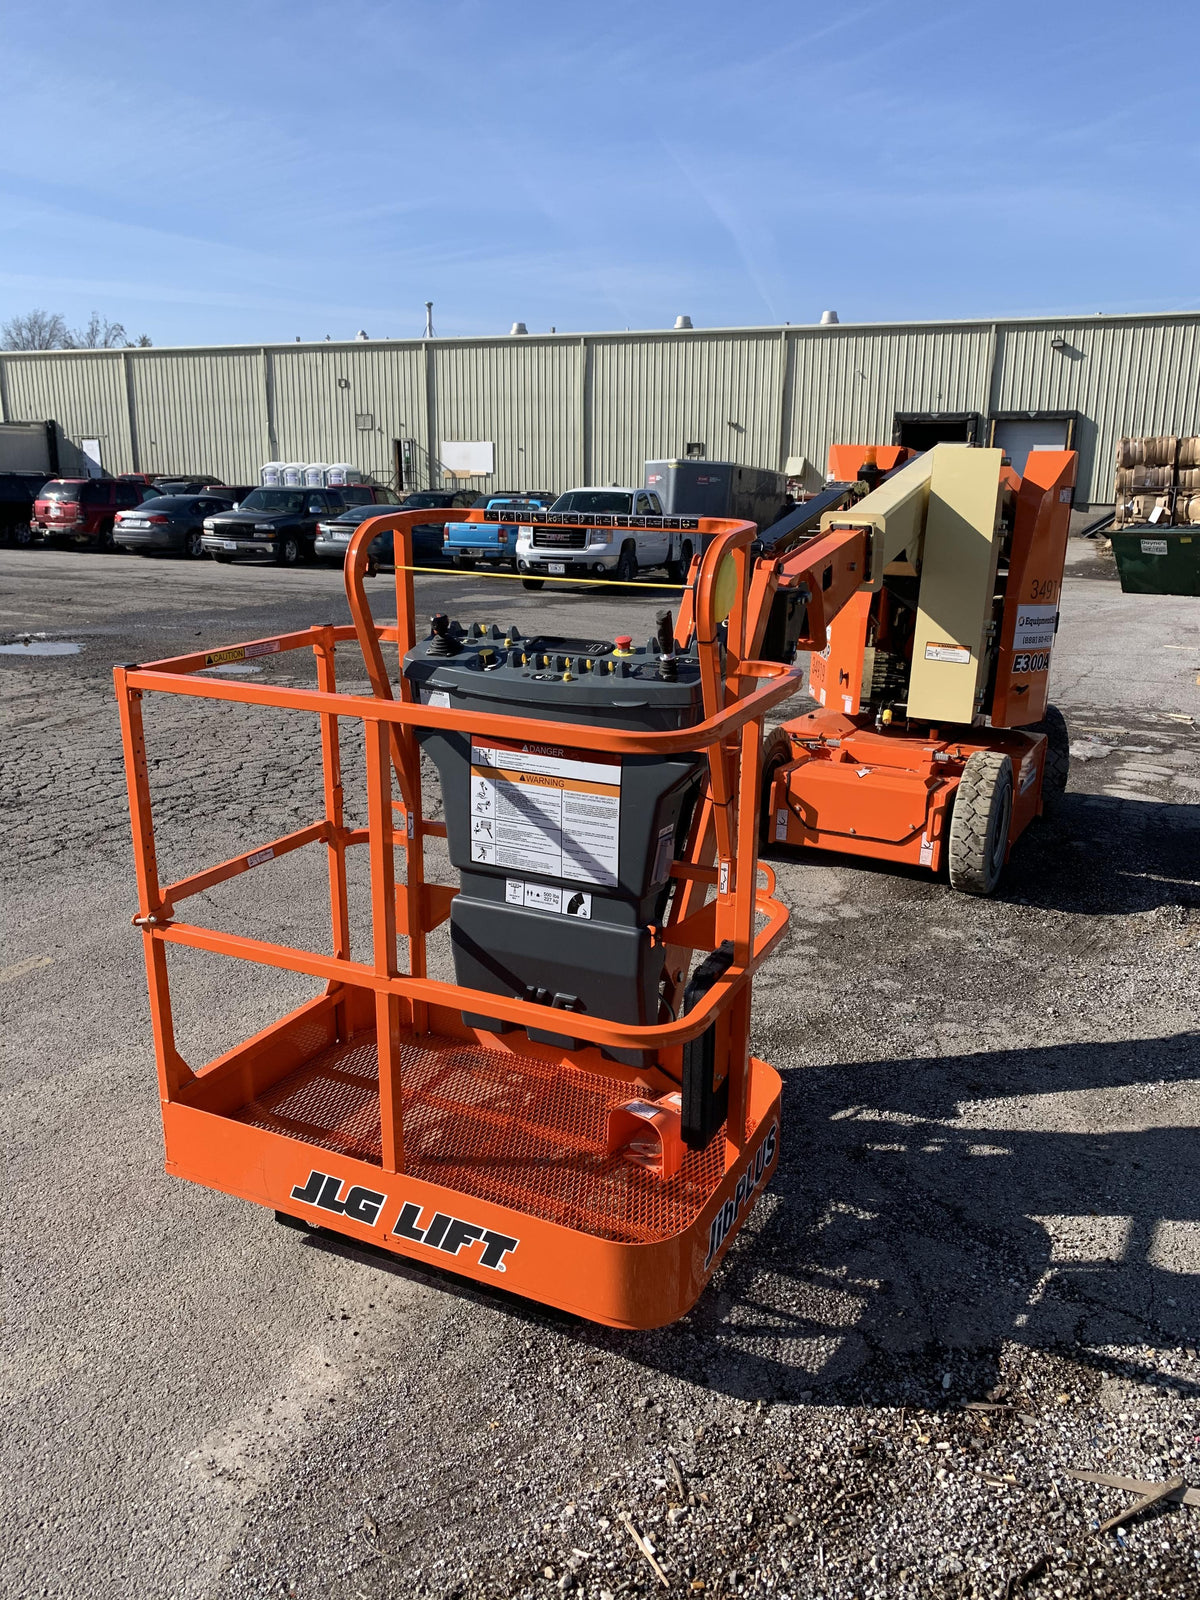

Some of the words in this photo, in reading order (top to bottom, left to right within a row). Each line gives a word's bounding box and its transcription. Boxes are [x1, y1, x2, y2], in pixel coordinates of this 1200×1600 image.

[213, 650, 243, 662] CAUTION
[529, 744, 564, 757] DANGER
[526, 775, 565, 788] WARNING
[290, 1169, 388, 1227] JLG
[392, 1201, 520, 1270] LIFT
